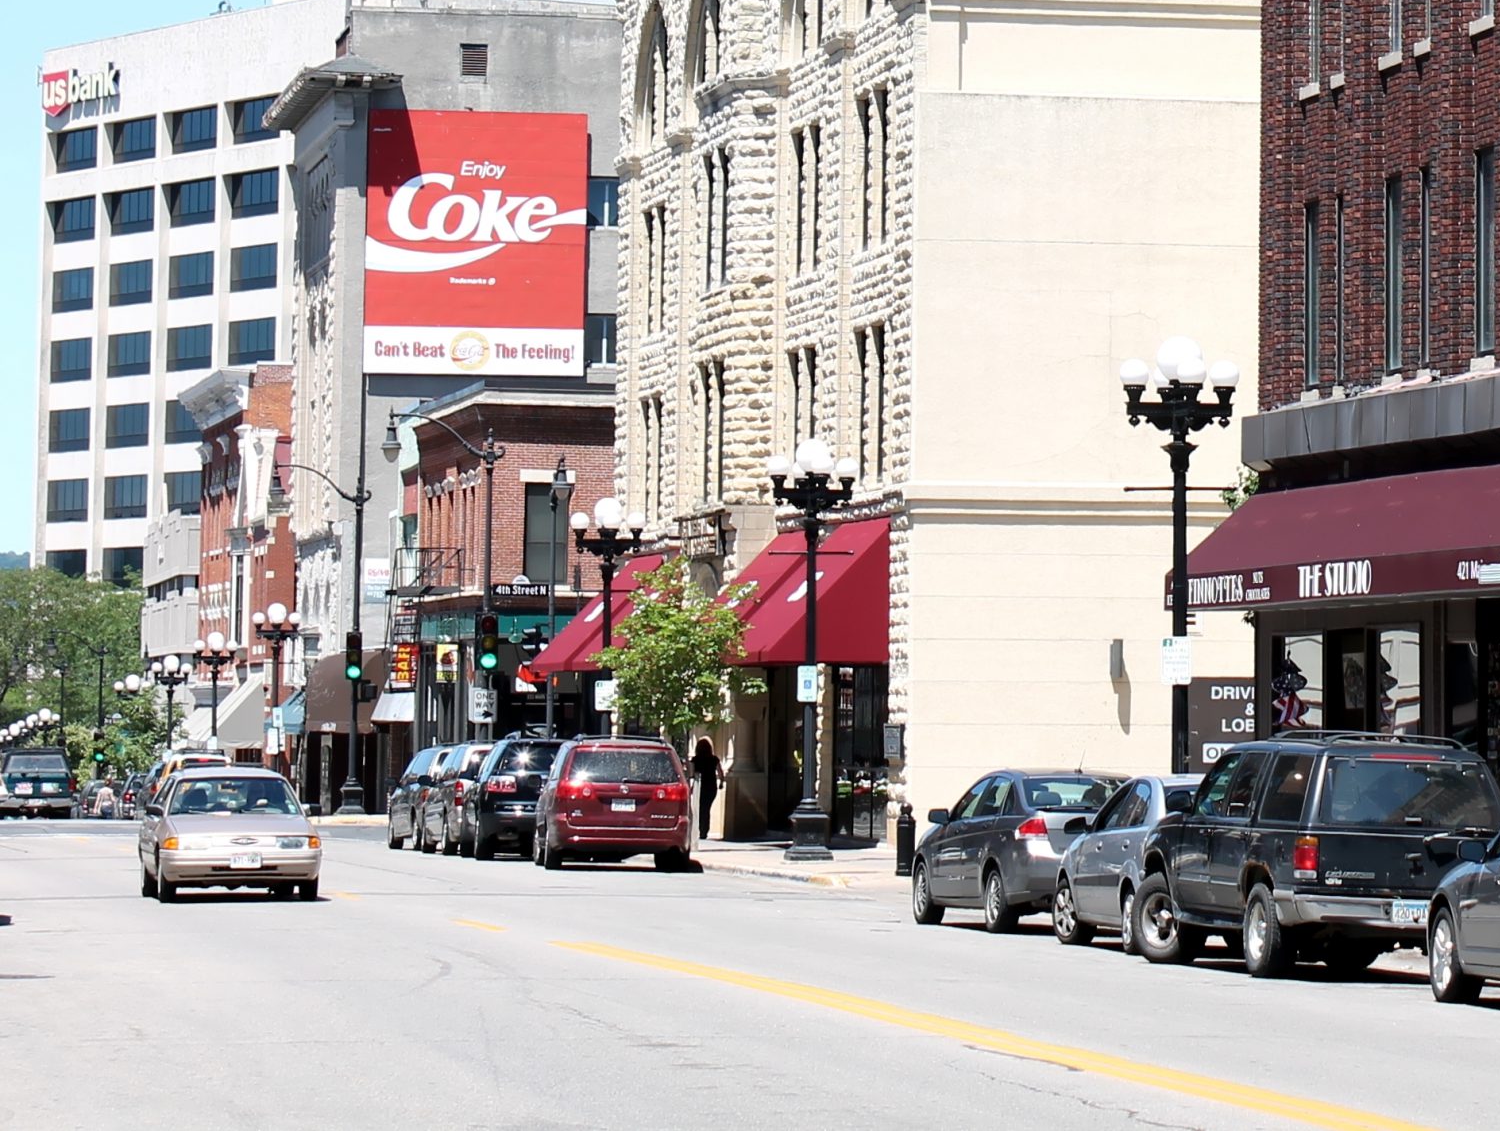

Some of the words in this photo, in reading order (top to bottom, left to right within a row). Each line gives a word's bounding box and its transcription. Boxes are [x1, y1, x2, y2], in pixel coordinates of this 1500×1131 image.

[460, 160, 506, 179] Enjoy
[387, 172, 557, 243] Coke
[374, 340, 410, 357] Can't
[412, 341, 446, 358] Beat
[494, 343, 518, 359] The
[521, 344, 575, 364] Feeling!
[1297, 564, 1323, 598] THE
[1324, 559, 1372, 597] STUDIO
[1456, 561, 1469, 580] 421
[495, 584, 511, 595] 4th
[512, 584, 539, 596] Street
[539, 585, 548, 596] N
[1187, 574, 1244, 605] FINNOTTES
[397, 646, 411, 682] BAR
[475, 701, 495, 709] WAY
[476, 692, 495, 700] ONE
[1245, 703, 1255, 716] &
